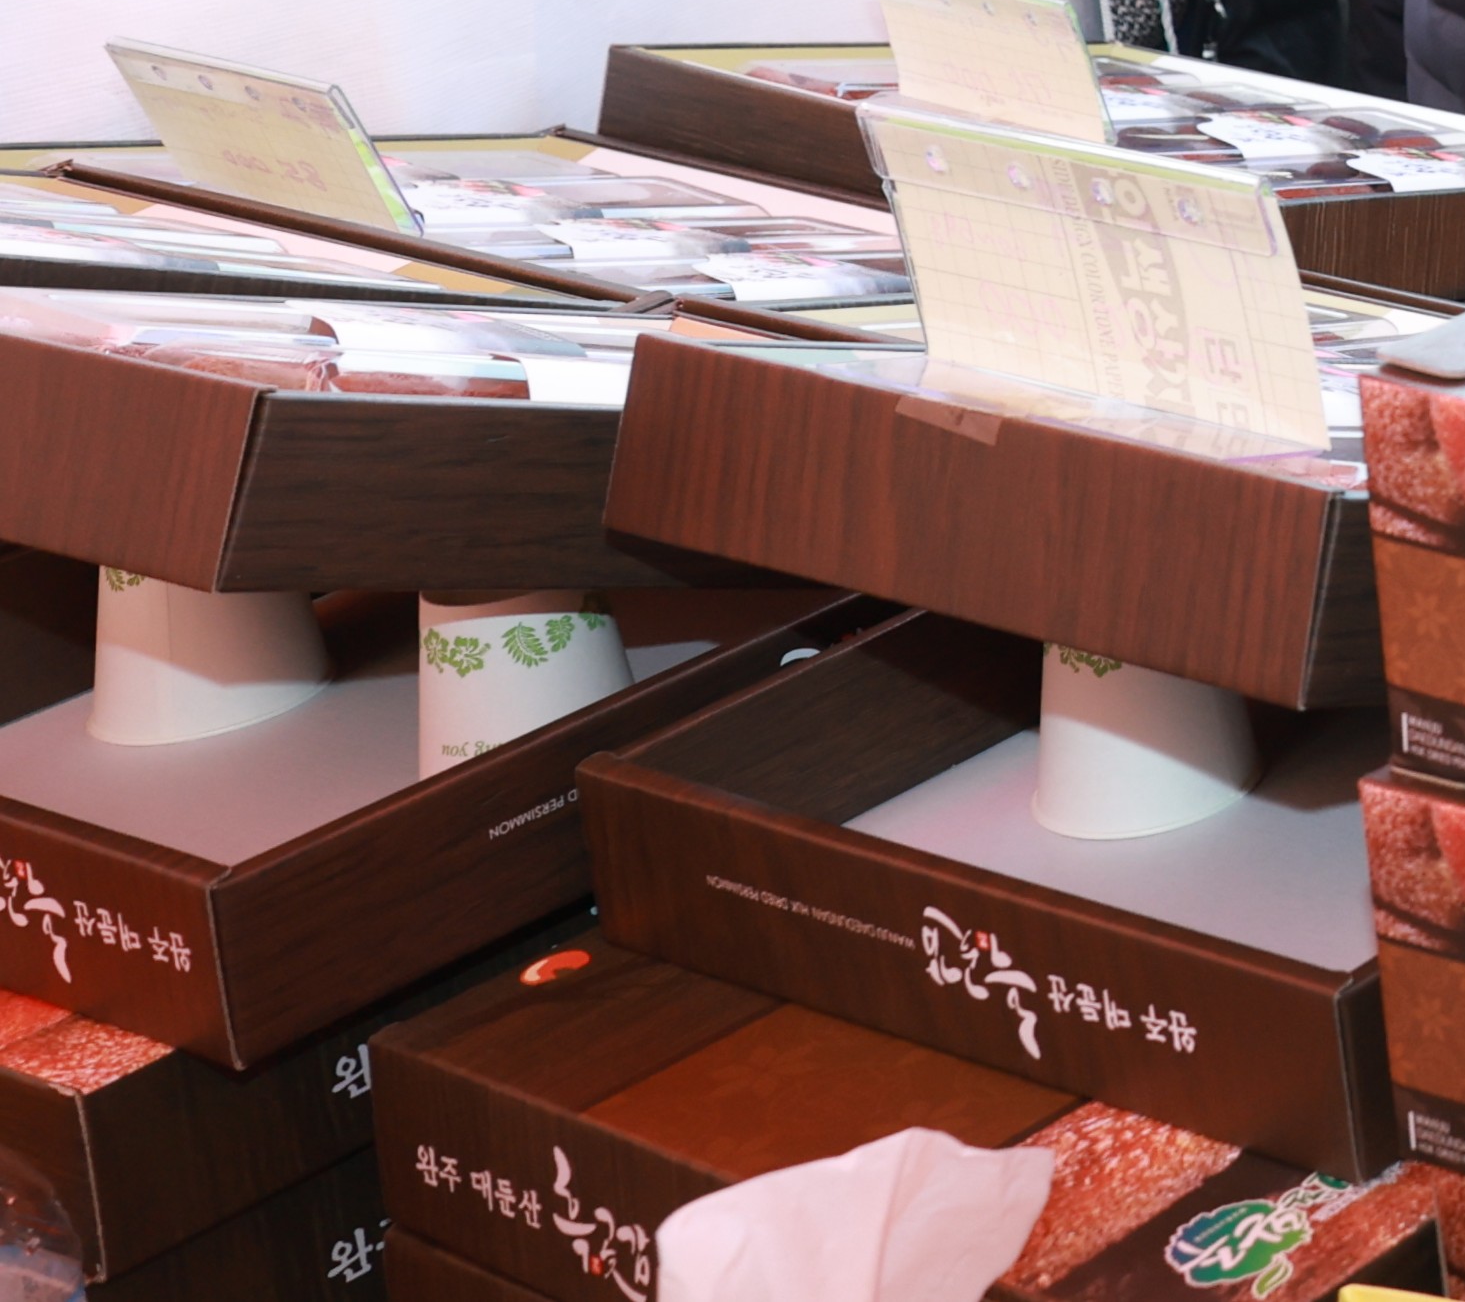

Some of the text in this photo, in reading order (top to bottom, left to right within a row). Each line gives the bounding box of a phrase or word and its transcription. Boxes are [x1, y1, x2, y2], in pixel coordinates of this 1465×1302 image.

[488, 795, 565, 841] PERSIMMON
[73, 900, 142, 952] 대둔산
[148, 926, 192, 973] 완주
[1047, 974, 1132, 1030] 대둔산
[1140, 1004, 1198, 1054] 완주
[416, 1145, 462, 1193] 완주
[469, 1170, 543, 1230] 대둔산
